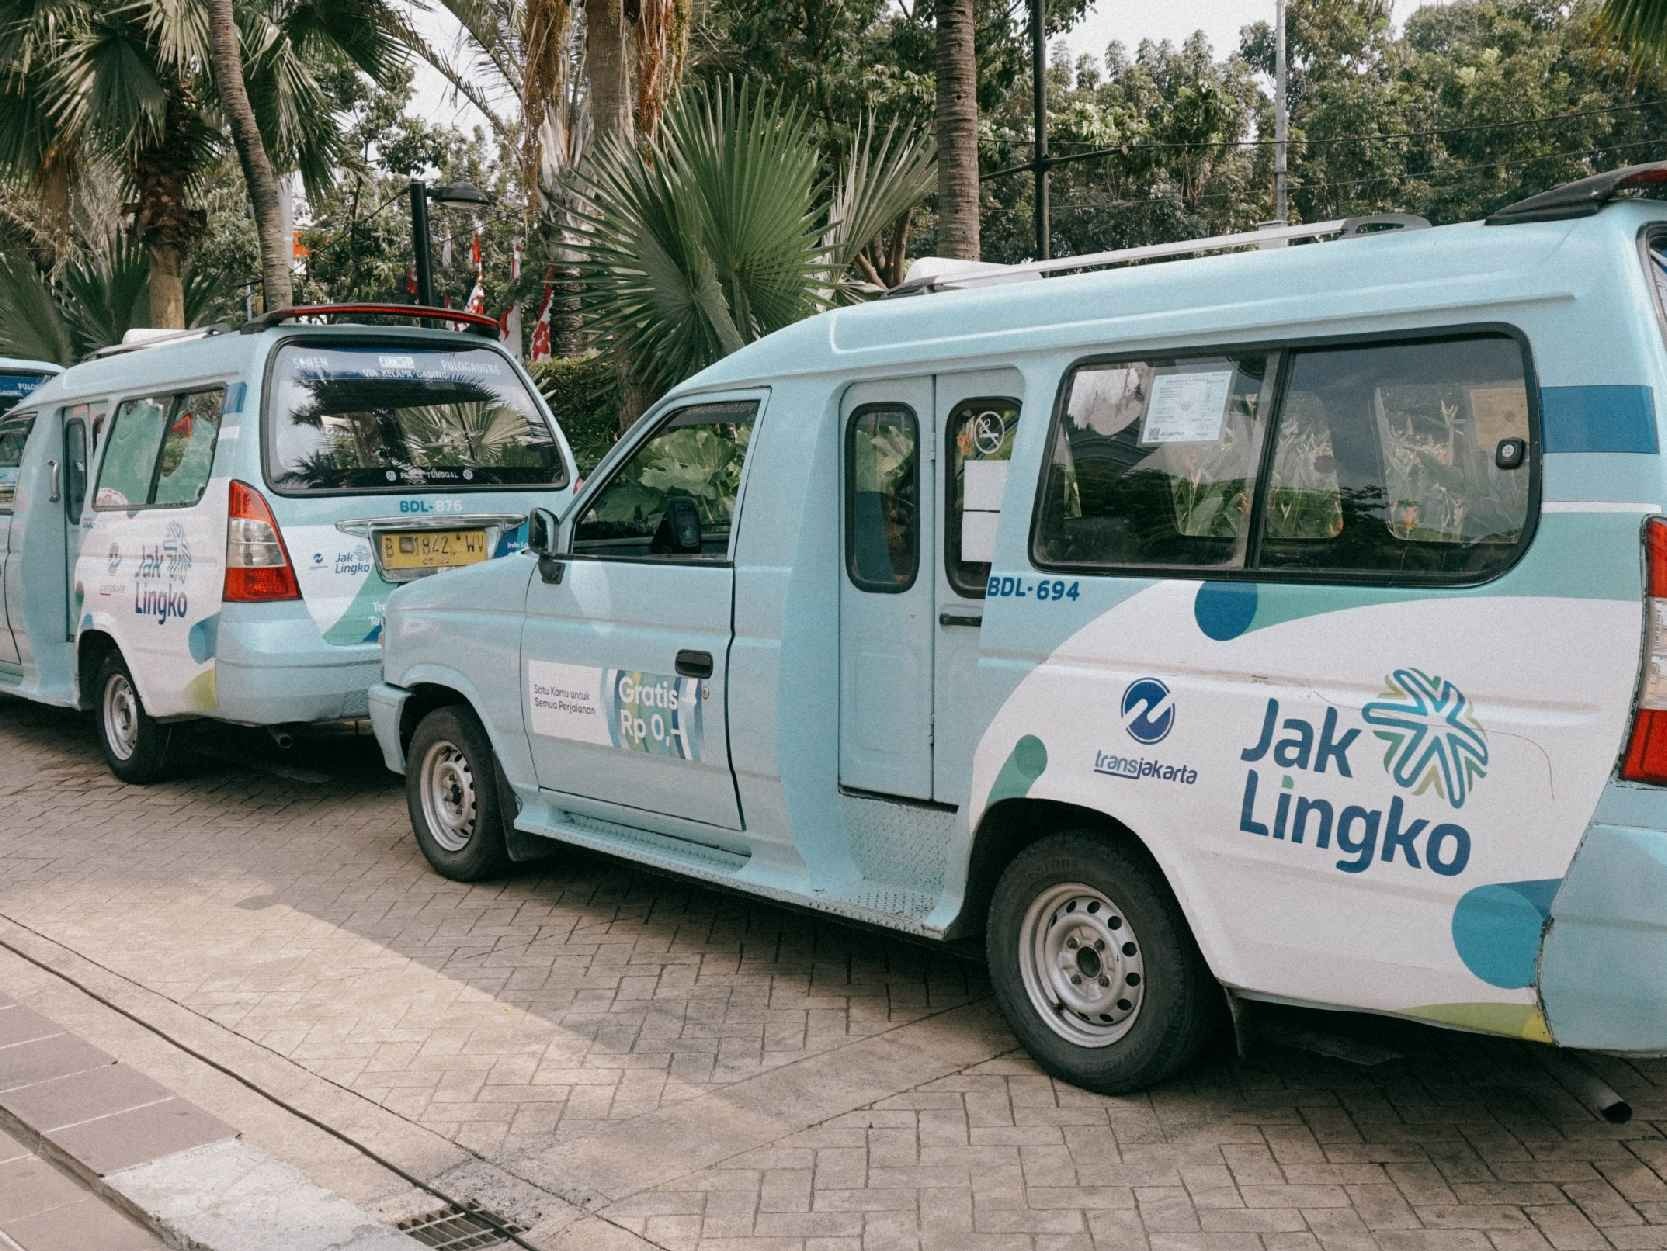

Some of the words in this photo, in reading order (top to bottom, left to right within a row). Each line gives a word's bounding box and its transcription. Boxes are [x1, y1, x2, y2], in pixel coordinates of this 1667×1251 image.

[399, 499, 463, 513] BDL-876
[134, 544, 163, 578] Jak
[335, 552, 354, 562] Jak
[335, 563, 369, 575] Lingko
[135, 581, 187, 624] Lingko
[534, 697, 558, 710] Semua
[559, 700, 595, 714] Perjalanan
[618, 675, 679, 711] Gratis
[620, 709, 647, 744] Rp
[1240, 697, 1362, 778] Jak
[1094, 750, 1198, 785] transjakarta
[1240, 769, 1471, 877] Lingko
